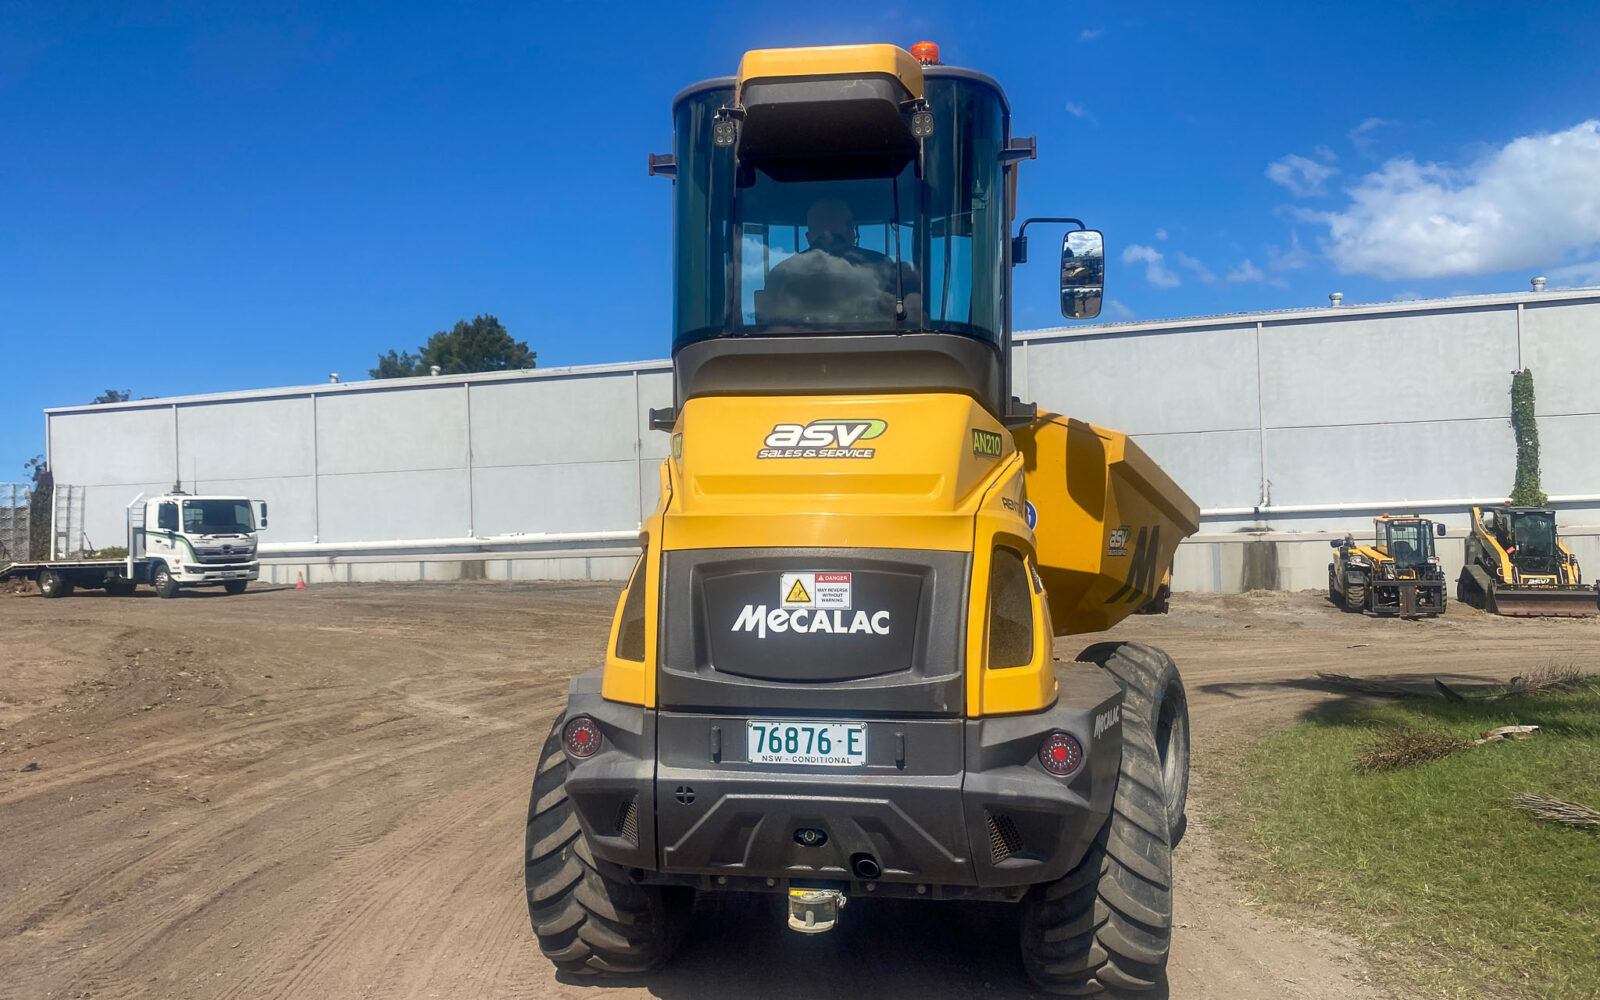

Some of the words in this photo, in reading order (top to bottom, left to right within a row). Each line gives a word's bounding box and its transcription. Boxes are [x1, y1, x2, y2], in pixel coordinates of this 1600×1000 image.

[973, 431, 1001, 456] AN210
[803, 449, 817, 458] &
[818, 449, 874, 458] SERVICE
[792, 756, 852, 764] CONDITIONAL
